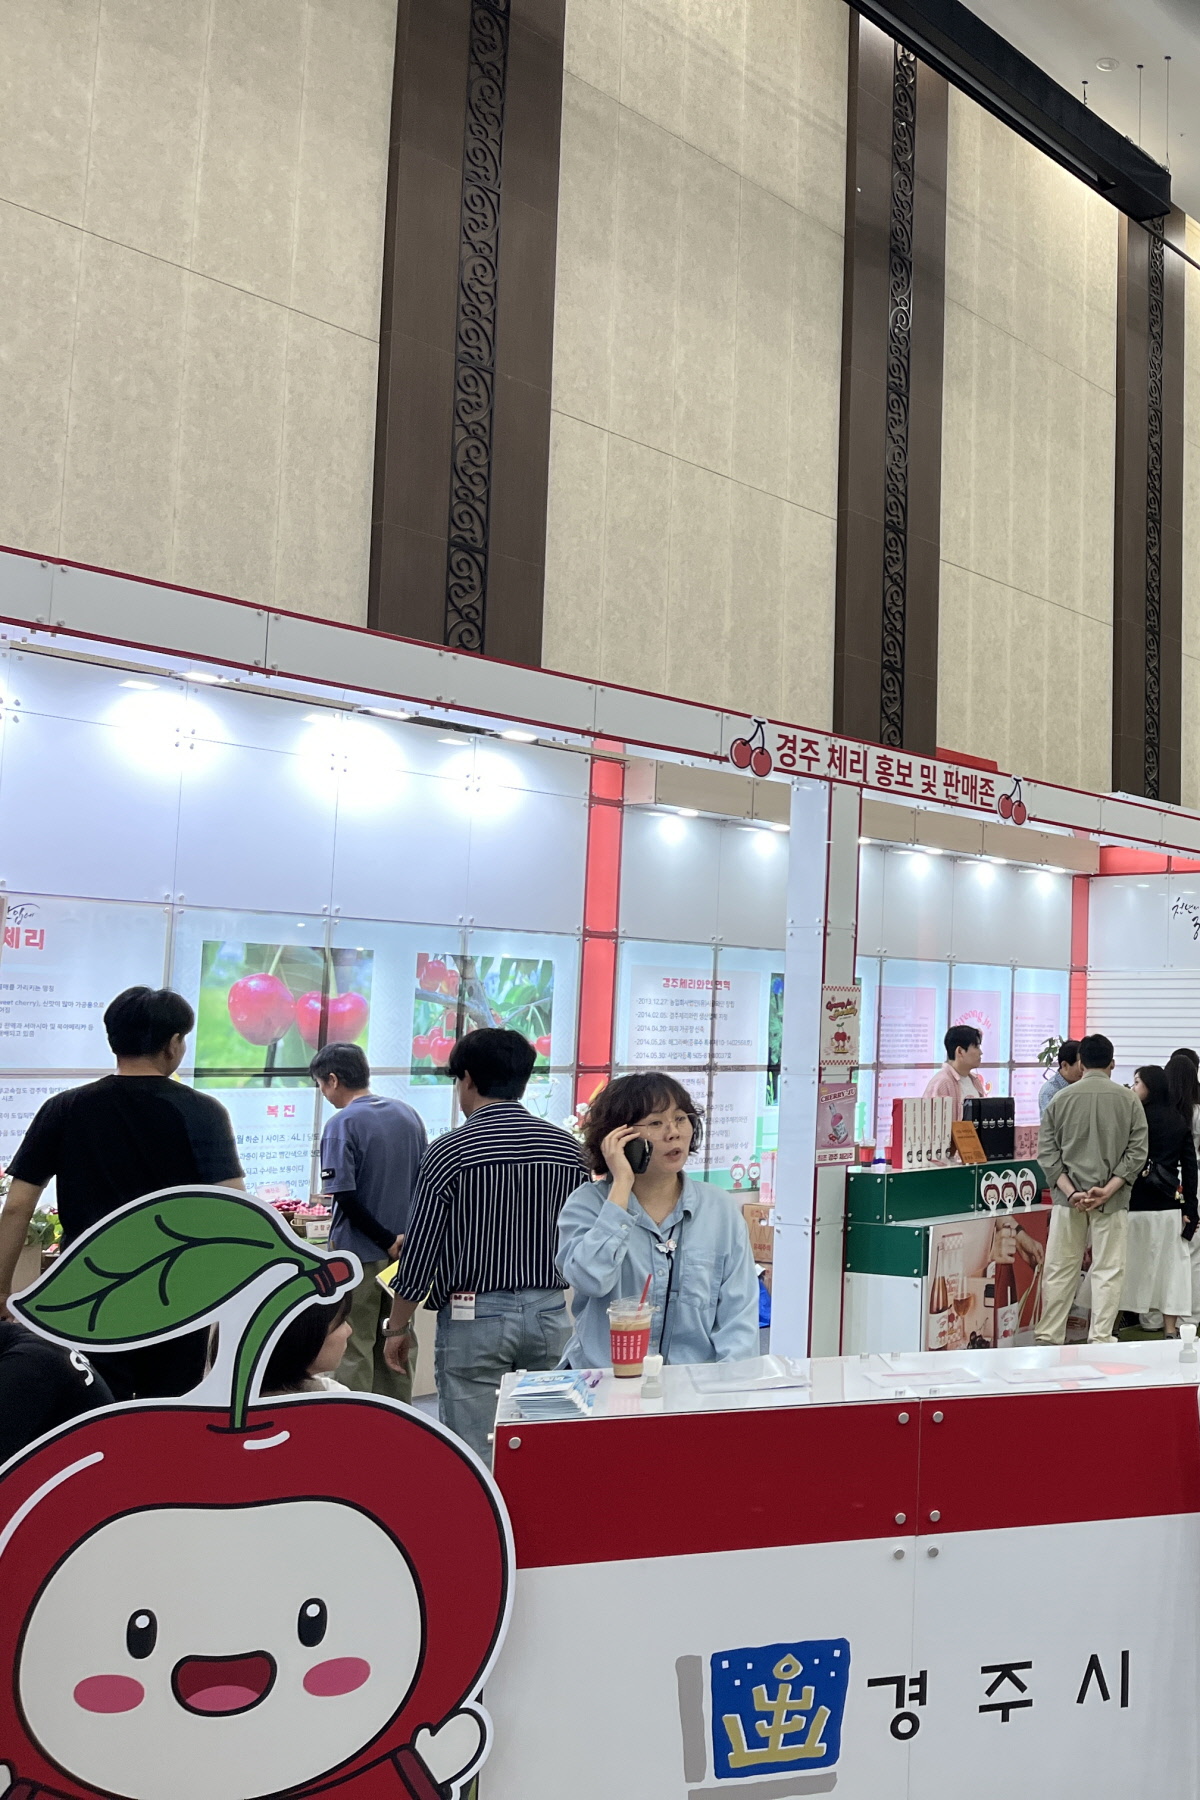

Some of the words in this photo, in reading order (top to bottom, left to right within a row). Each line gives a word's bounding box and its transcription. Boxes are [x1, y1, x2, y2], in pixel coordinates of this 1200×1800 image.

[776, 733, 821, 772] 경주
[826, 743, 867, 782] 체리
[875, 754, 914, 788] 홍보
[920, 761, 937, 796] 및
[942, 770, 996, 807] 판매존
[867, 1650, 1129, 1741] 경주시
